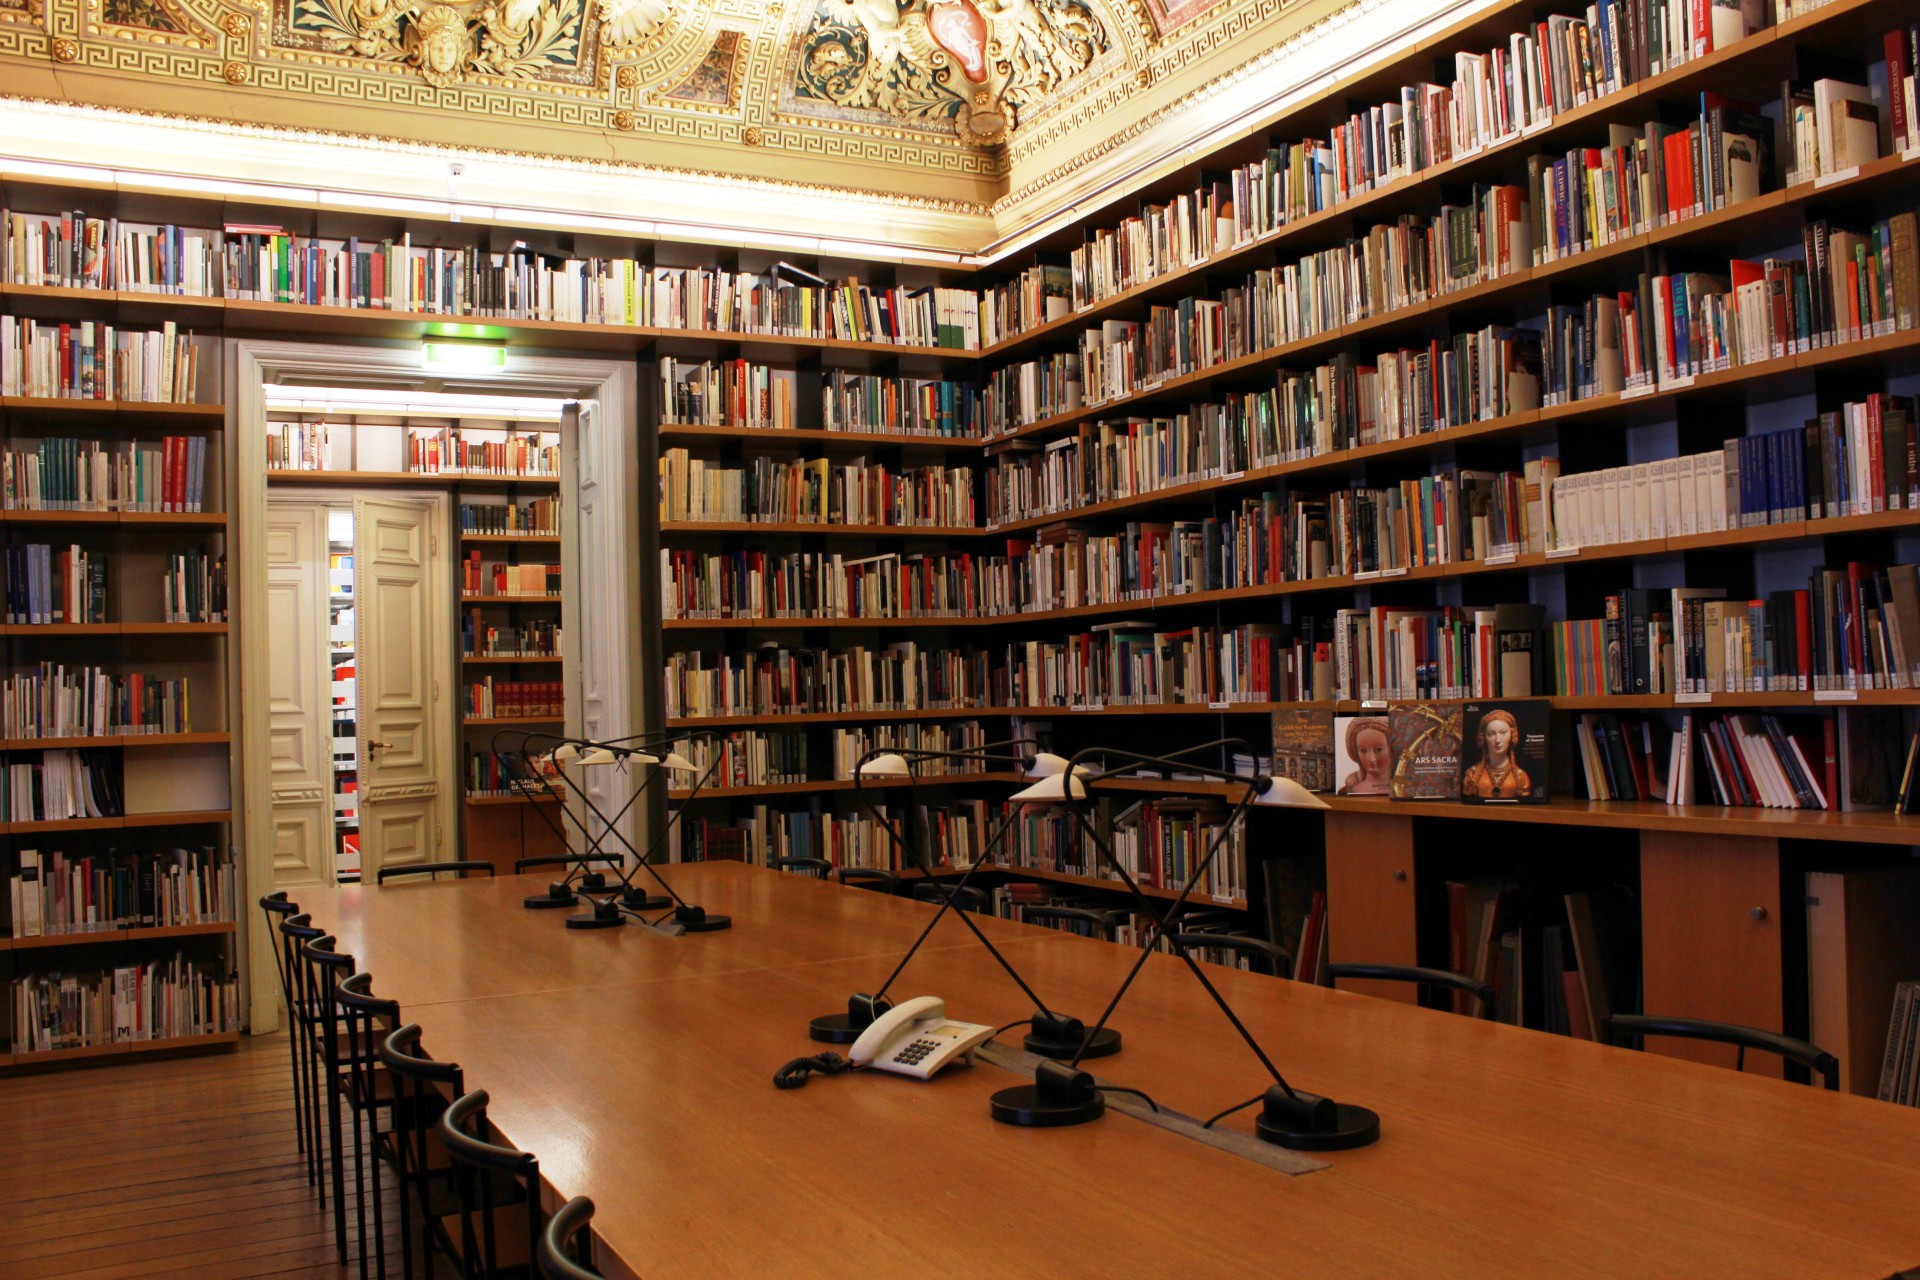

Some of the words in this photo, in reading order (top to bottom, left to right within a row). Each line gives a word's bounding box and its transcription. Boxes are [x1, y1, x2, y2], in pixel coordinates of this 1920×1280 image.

[1891, 60, 1900, 104] GOURMAND
[1816, 227, 1825, 268] STILLEBEN
[1674, 282, 1685, 317] Blau:
[1338, 634, 1347, 679] slowakische
[1414, 756, 1431, 764] ARS
[1431, 756, 1458, 764] SACRA
